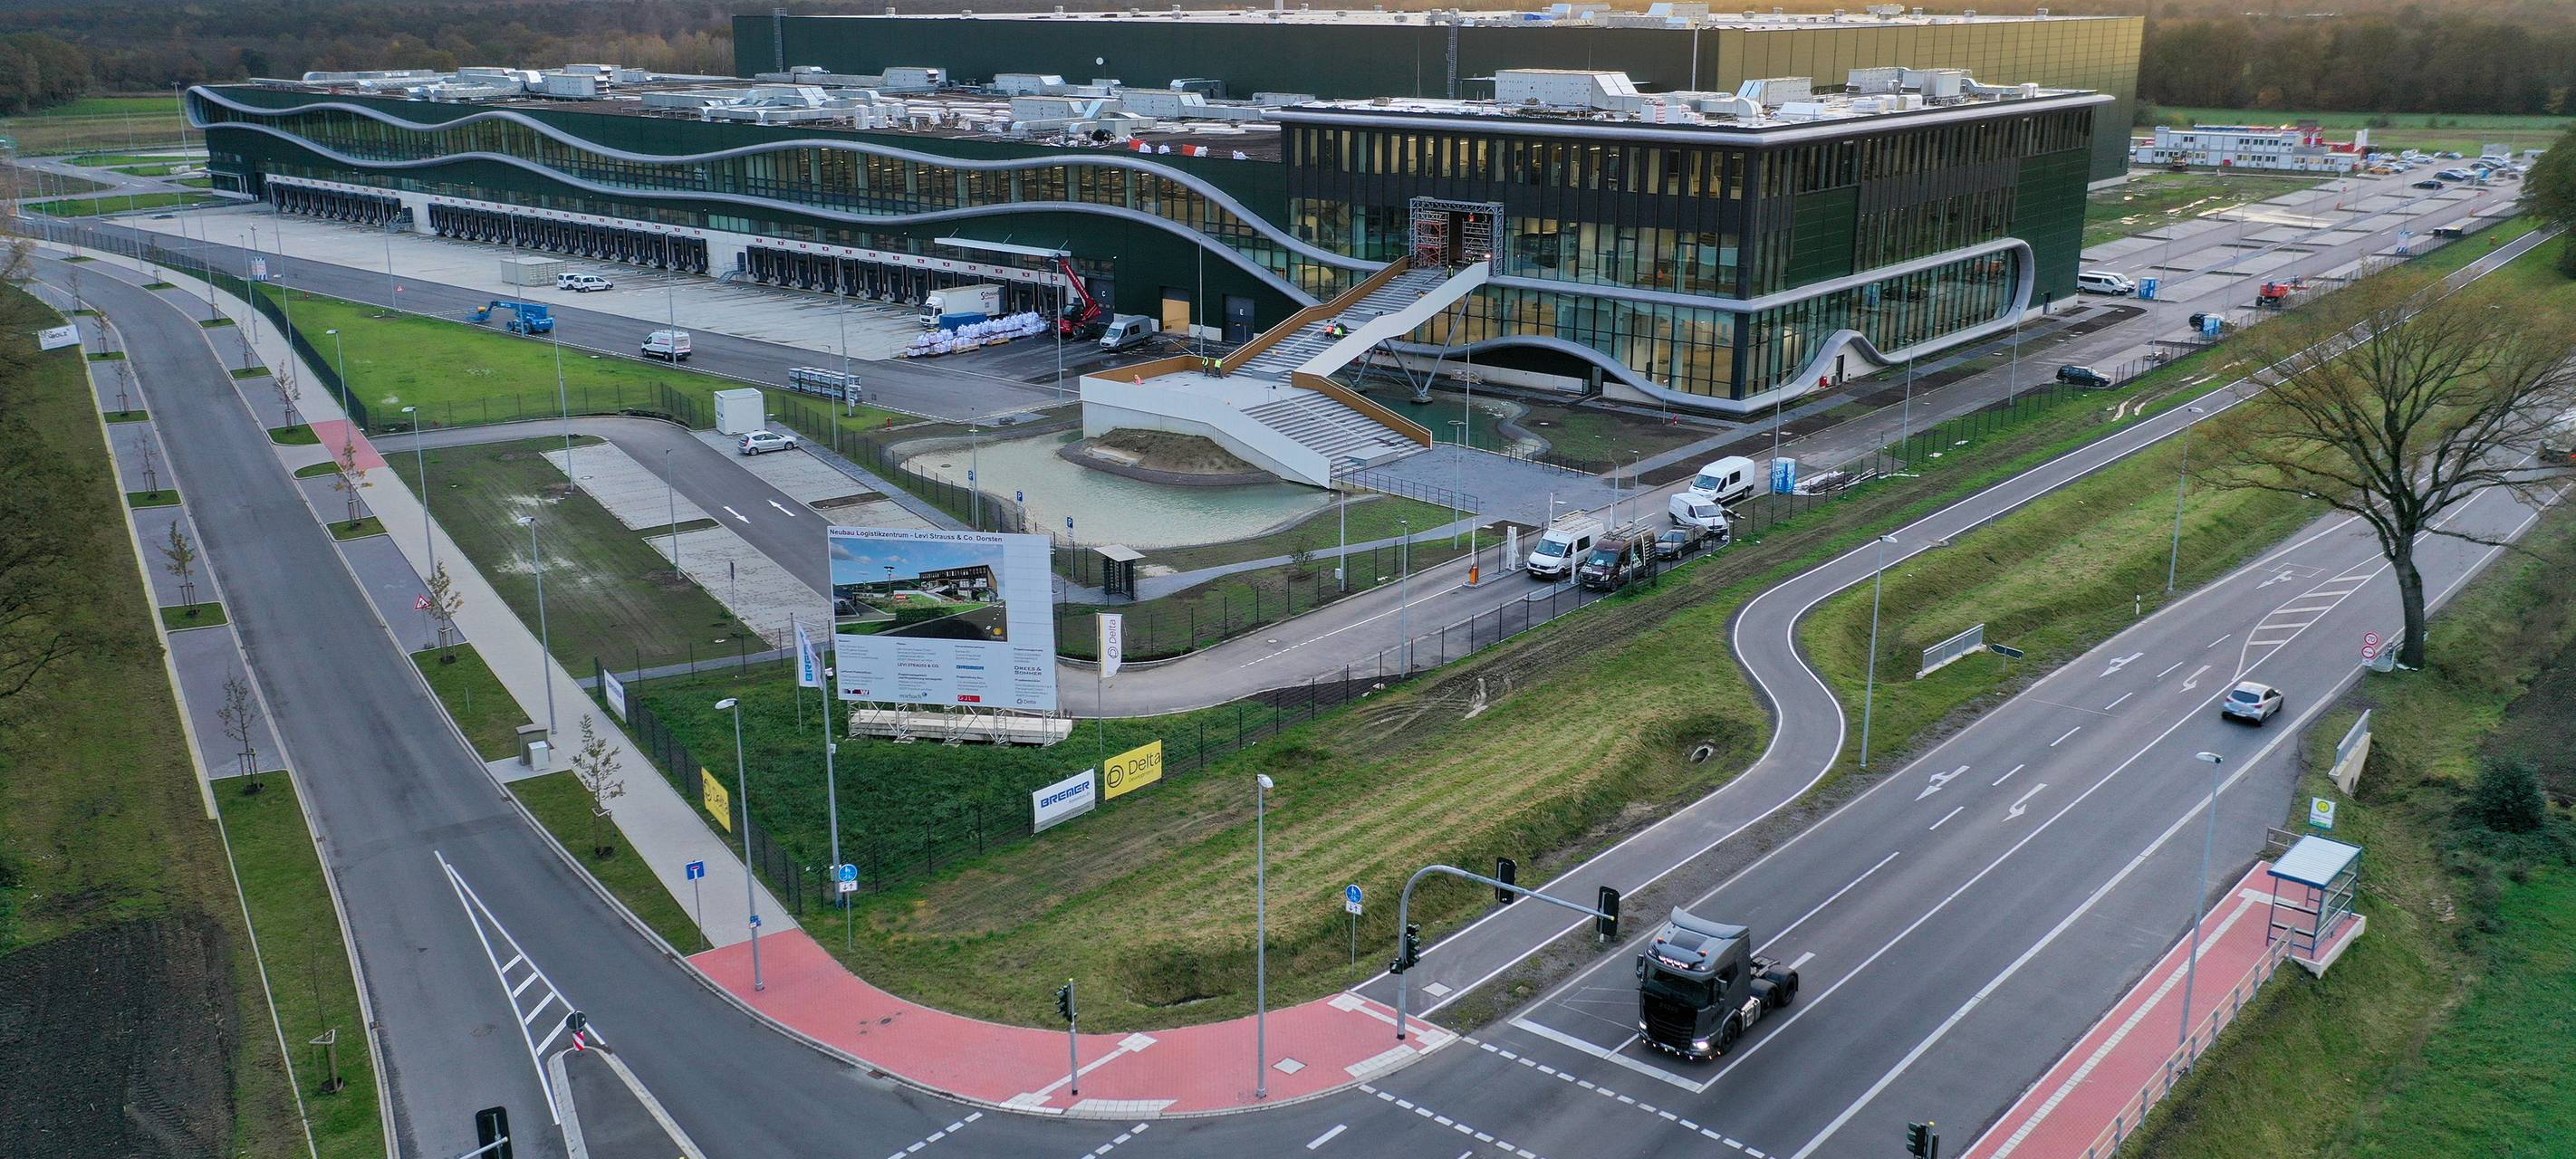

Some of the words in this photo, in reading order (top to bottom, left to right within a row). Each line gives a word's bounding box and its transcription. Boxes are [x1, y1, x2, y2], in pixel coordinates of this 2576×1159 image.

[1239, 308, 1245, 316] E
[856, 530, 908, 538] Logistikzentrum
[1109, 618, 1117, 644] Delta
[1129, 752, 1161, 776] Delta
[1041, 781, 1090, 808] BREMER
